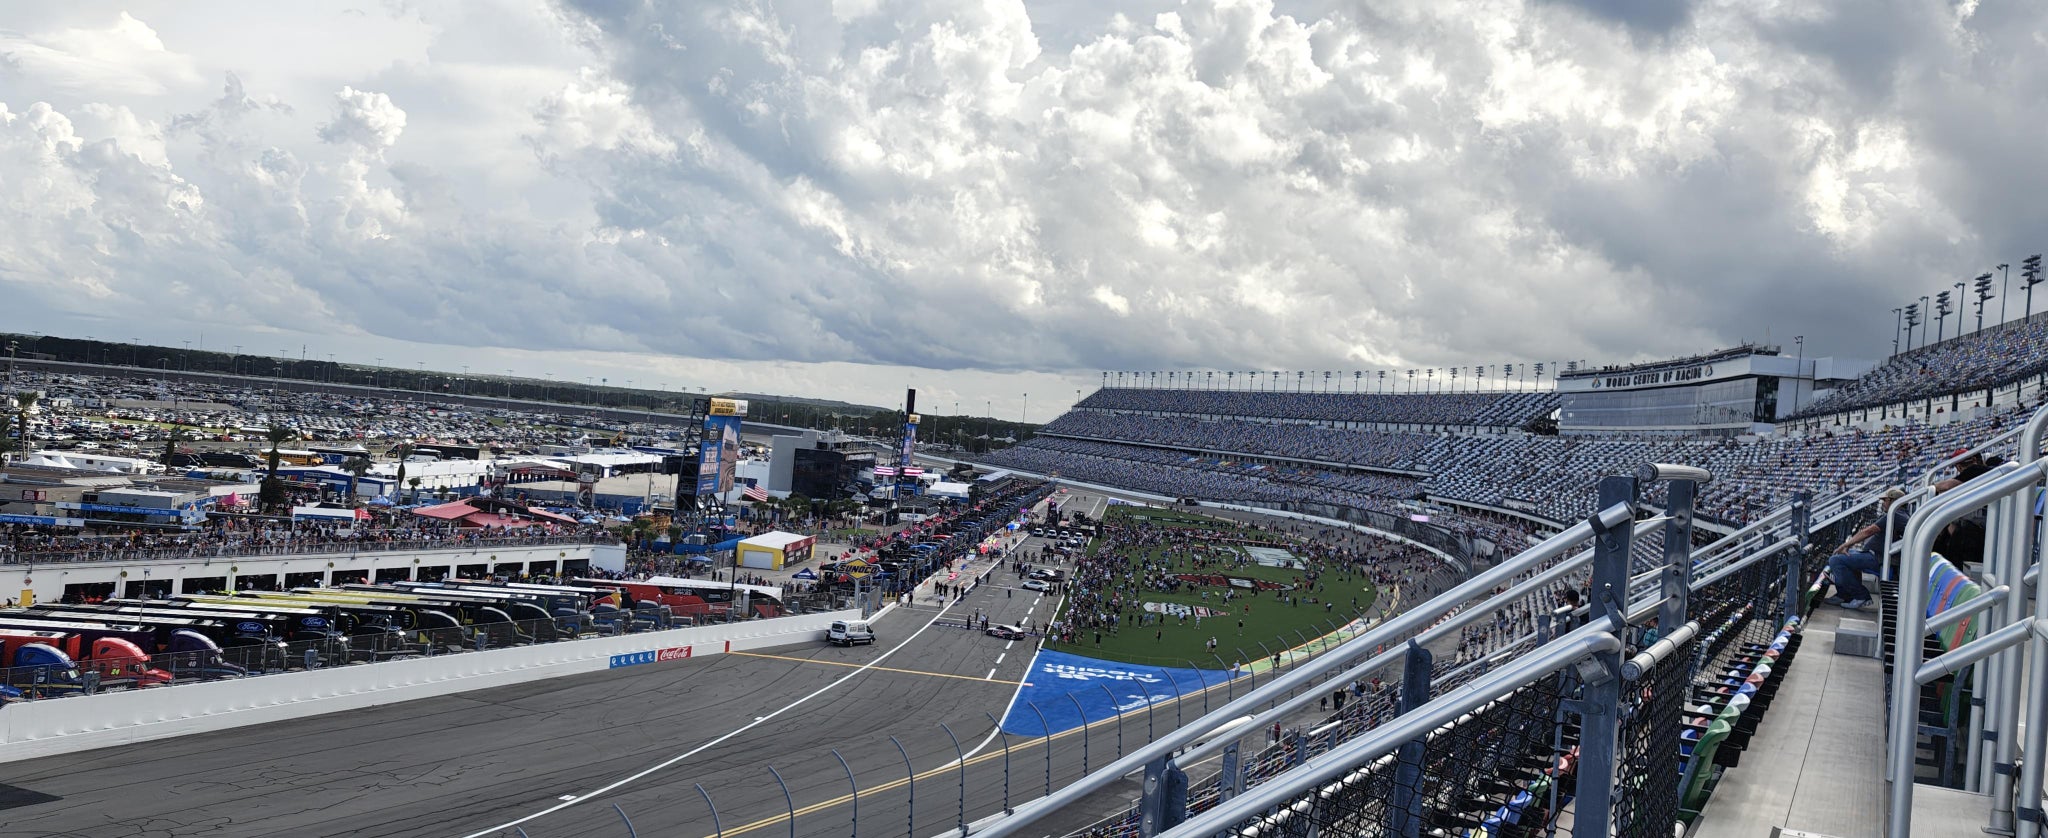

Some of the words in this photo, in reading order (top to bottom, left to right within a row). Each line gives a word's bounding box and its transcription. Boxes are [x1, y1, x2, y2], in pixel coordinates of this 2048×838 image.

[1606, 377, 1630, 388] WORLD
[1633, 373, 1659, 386] CENTER
[1663, 371, 1672, 383] OF
[1675, 367, 1702, 381] RACING
[838, 563, 879, 574] SUNOCO
[111, 668, 121, 676] 24
[1045, 663, 1153, 679] Health
